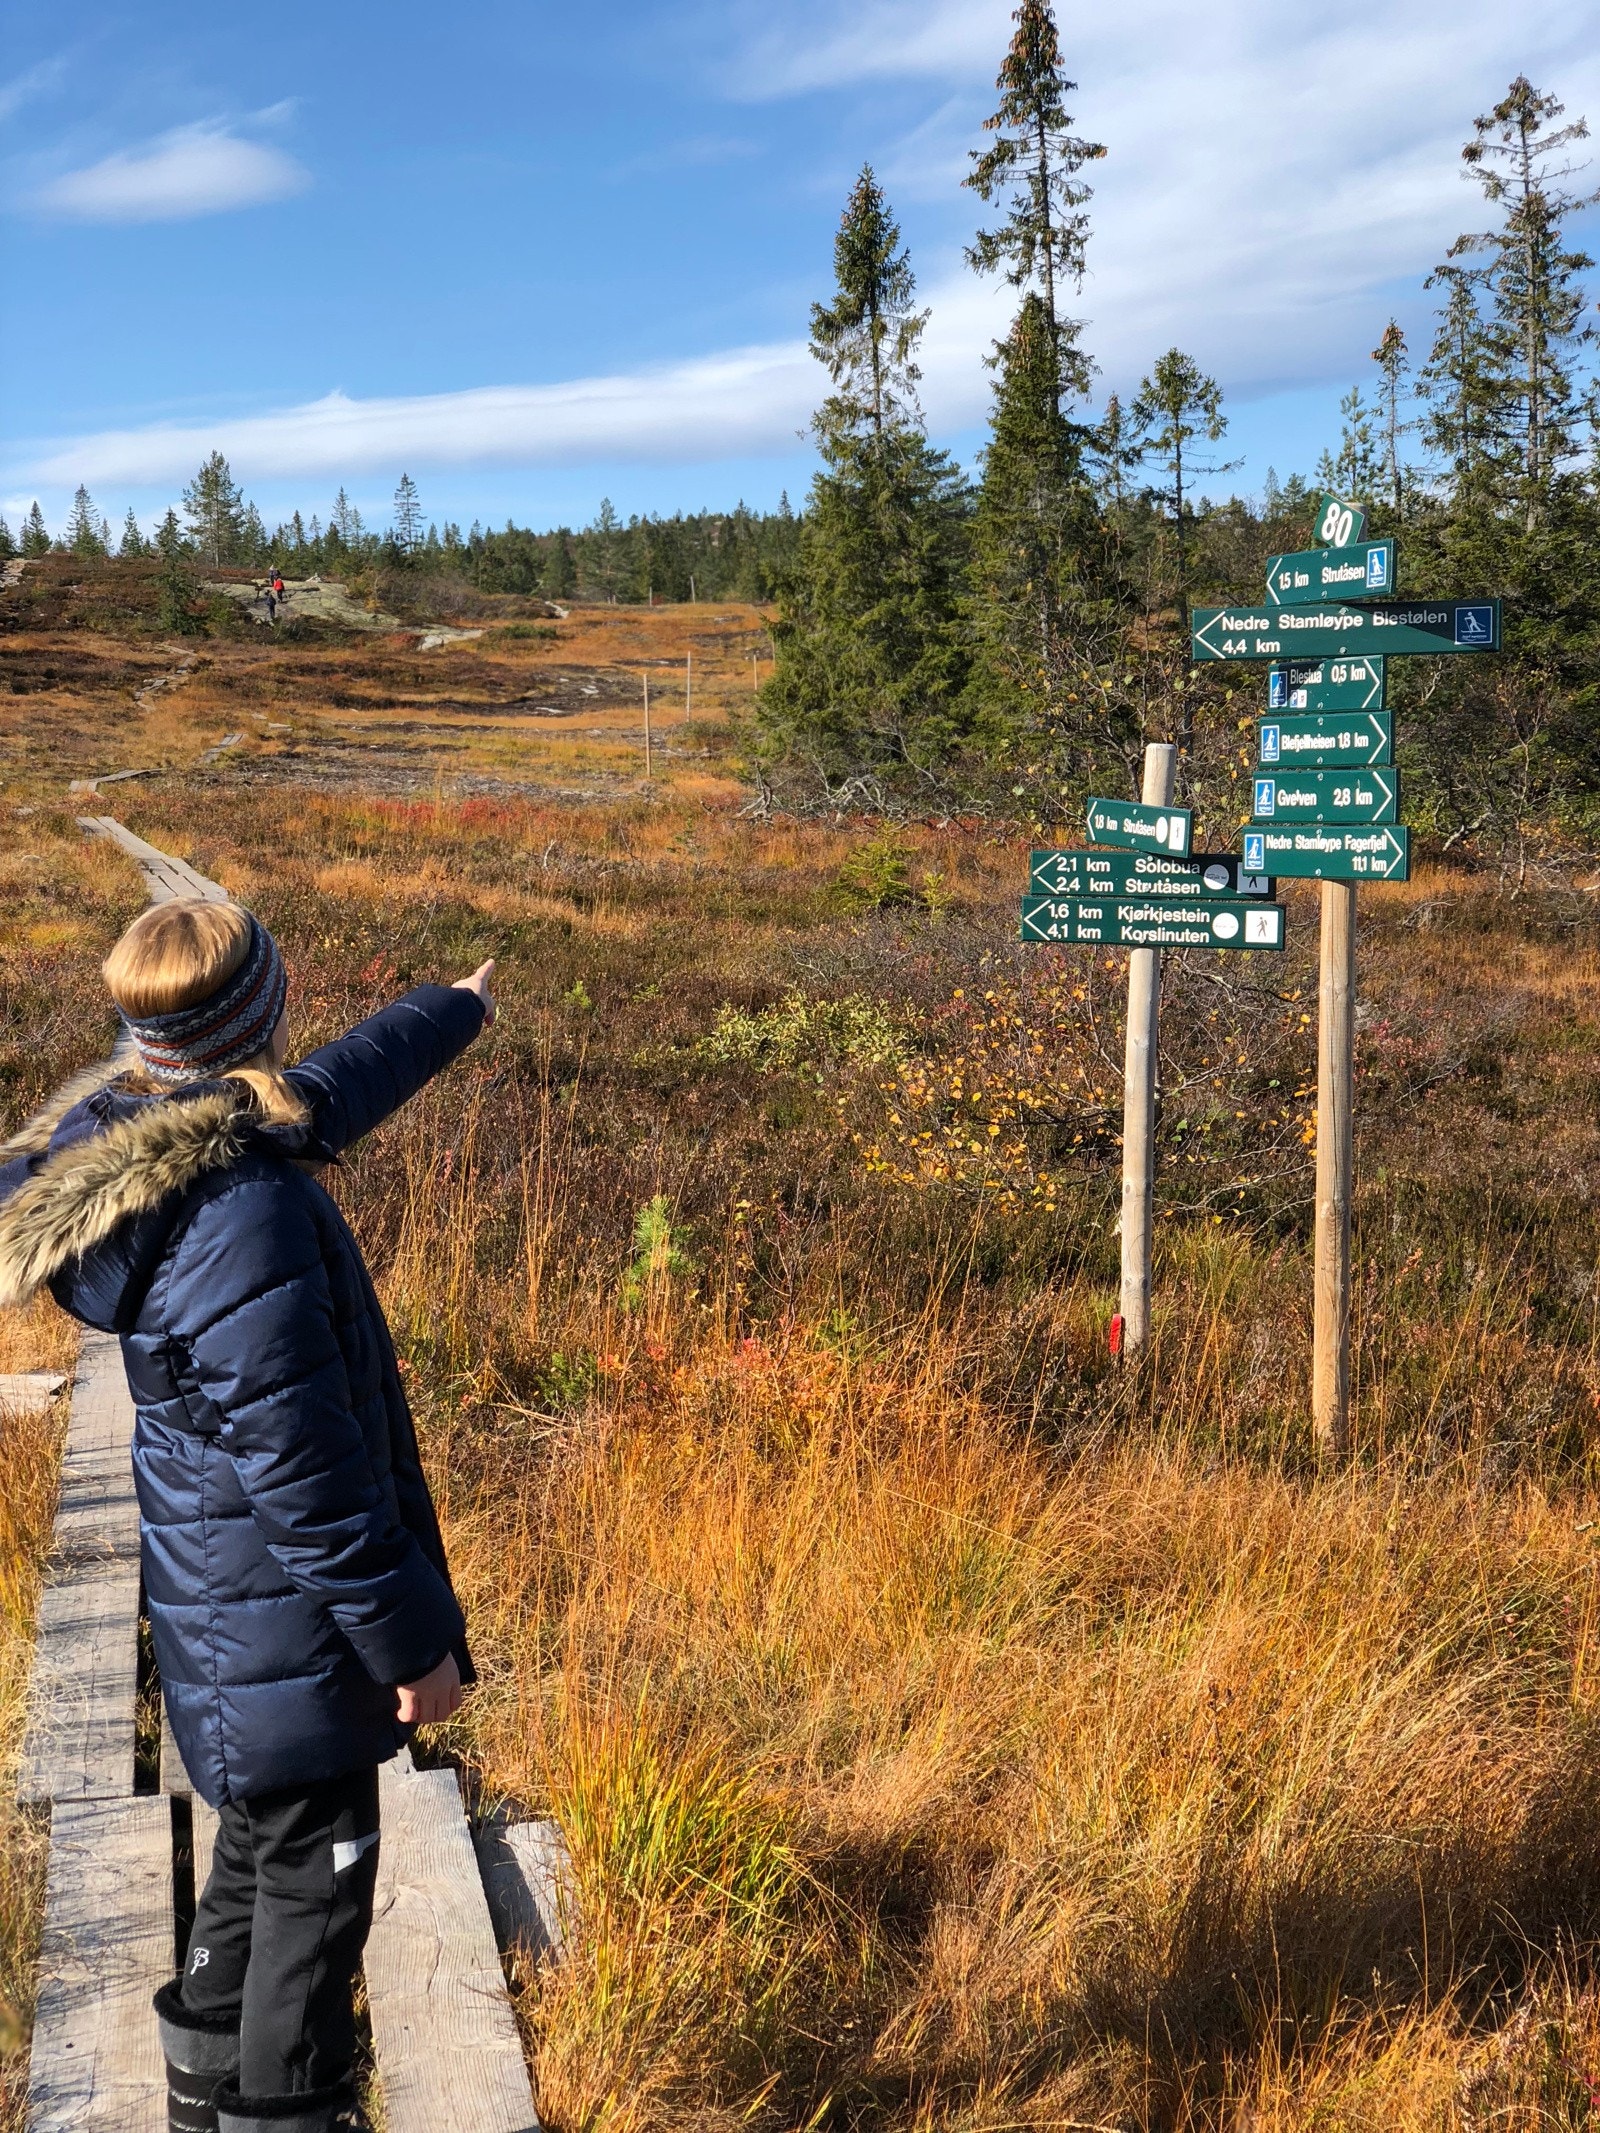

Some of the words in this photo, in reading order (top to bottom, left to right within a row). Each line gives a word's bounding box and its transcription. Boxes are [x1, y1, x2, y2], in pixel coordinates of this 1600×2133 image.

[1321, 502, 1353, 547] 80
[1294, 570, 1309, 588] km
[1321, 562, 1365, 584] Strutåsen
[1222, 615, 1270, 631] Nedre
[1278, 612, 1363, 631] Stamløype
[1373, 610, 1447, 627] Blestølen
[1222, 639, 1247, 655] 4,4
[1256, 639, 1280, 653] km
[1290, 668, 1322, 685] Blestua
[1331, 664, 1347, 683] 0,5
[1350, 663, 1366, 681] km
[1281, 733, 1335, 752] Blefjellheisen
[1354, 732, 1369, 748] km
[1333, 787, 1351, 807] 2,8
[1355, 787, 1373, 805] km
[1106, 816, 1118, 831] km
[1123, 818, 1156, 837] Strutåsen
[1265, 834, 1292, 850] Nedre
[1295, 834, 1341, 853] Stamløype
[1344, 834, 1387, 853] Fagerfjell
[1056, 857, 1077, 873] 2,1
[1086, 857, 1111, 872] km
[1135, 858, 1200, 874] Solobua
[1371, 856, 1387, 871] km
[1056, 877, 1081, 893] 2,4
[1089, 878, 1114, 892] km
[1125, 877, 1201, 895] Strutåsen
[1047, 903, 1070, 919] 1,6
[1079, 905, 1103, 919] km
[1118, 905, 1210, 924] Kjørkjestein
[1047, 924, 1069, 940] 4,1
[1077, 925, 1102, 940] km
[1121, 926, 1210, 944] Korslinuten
